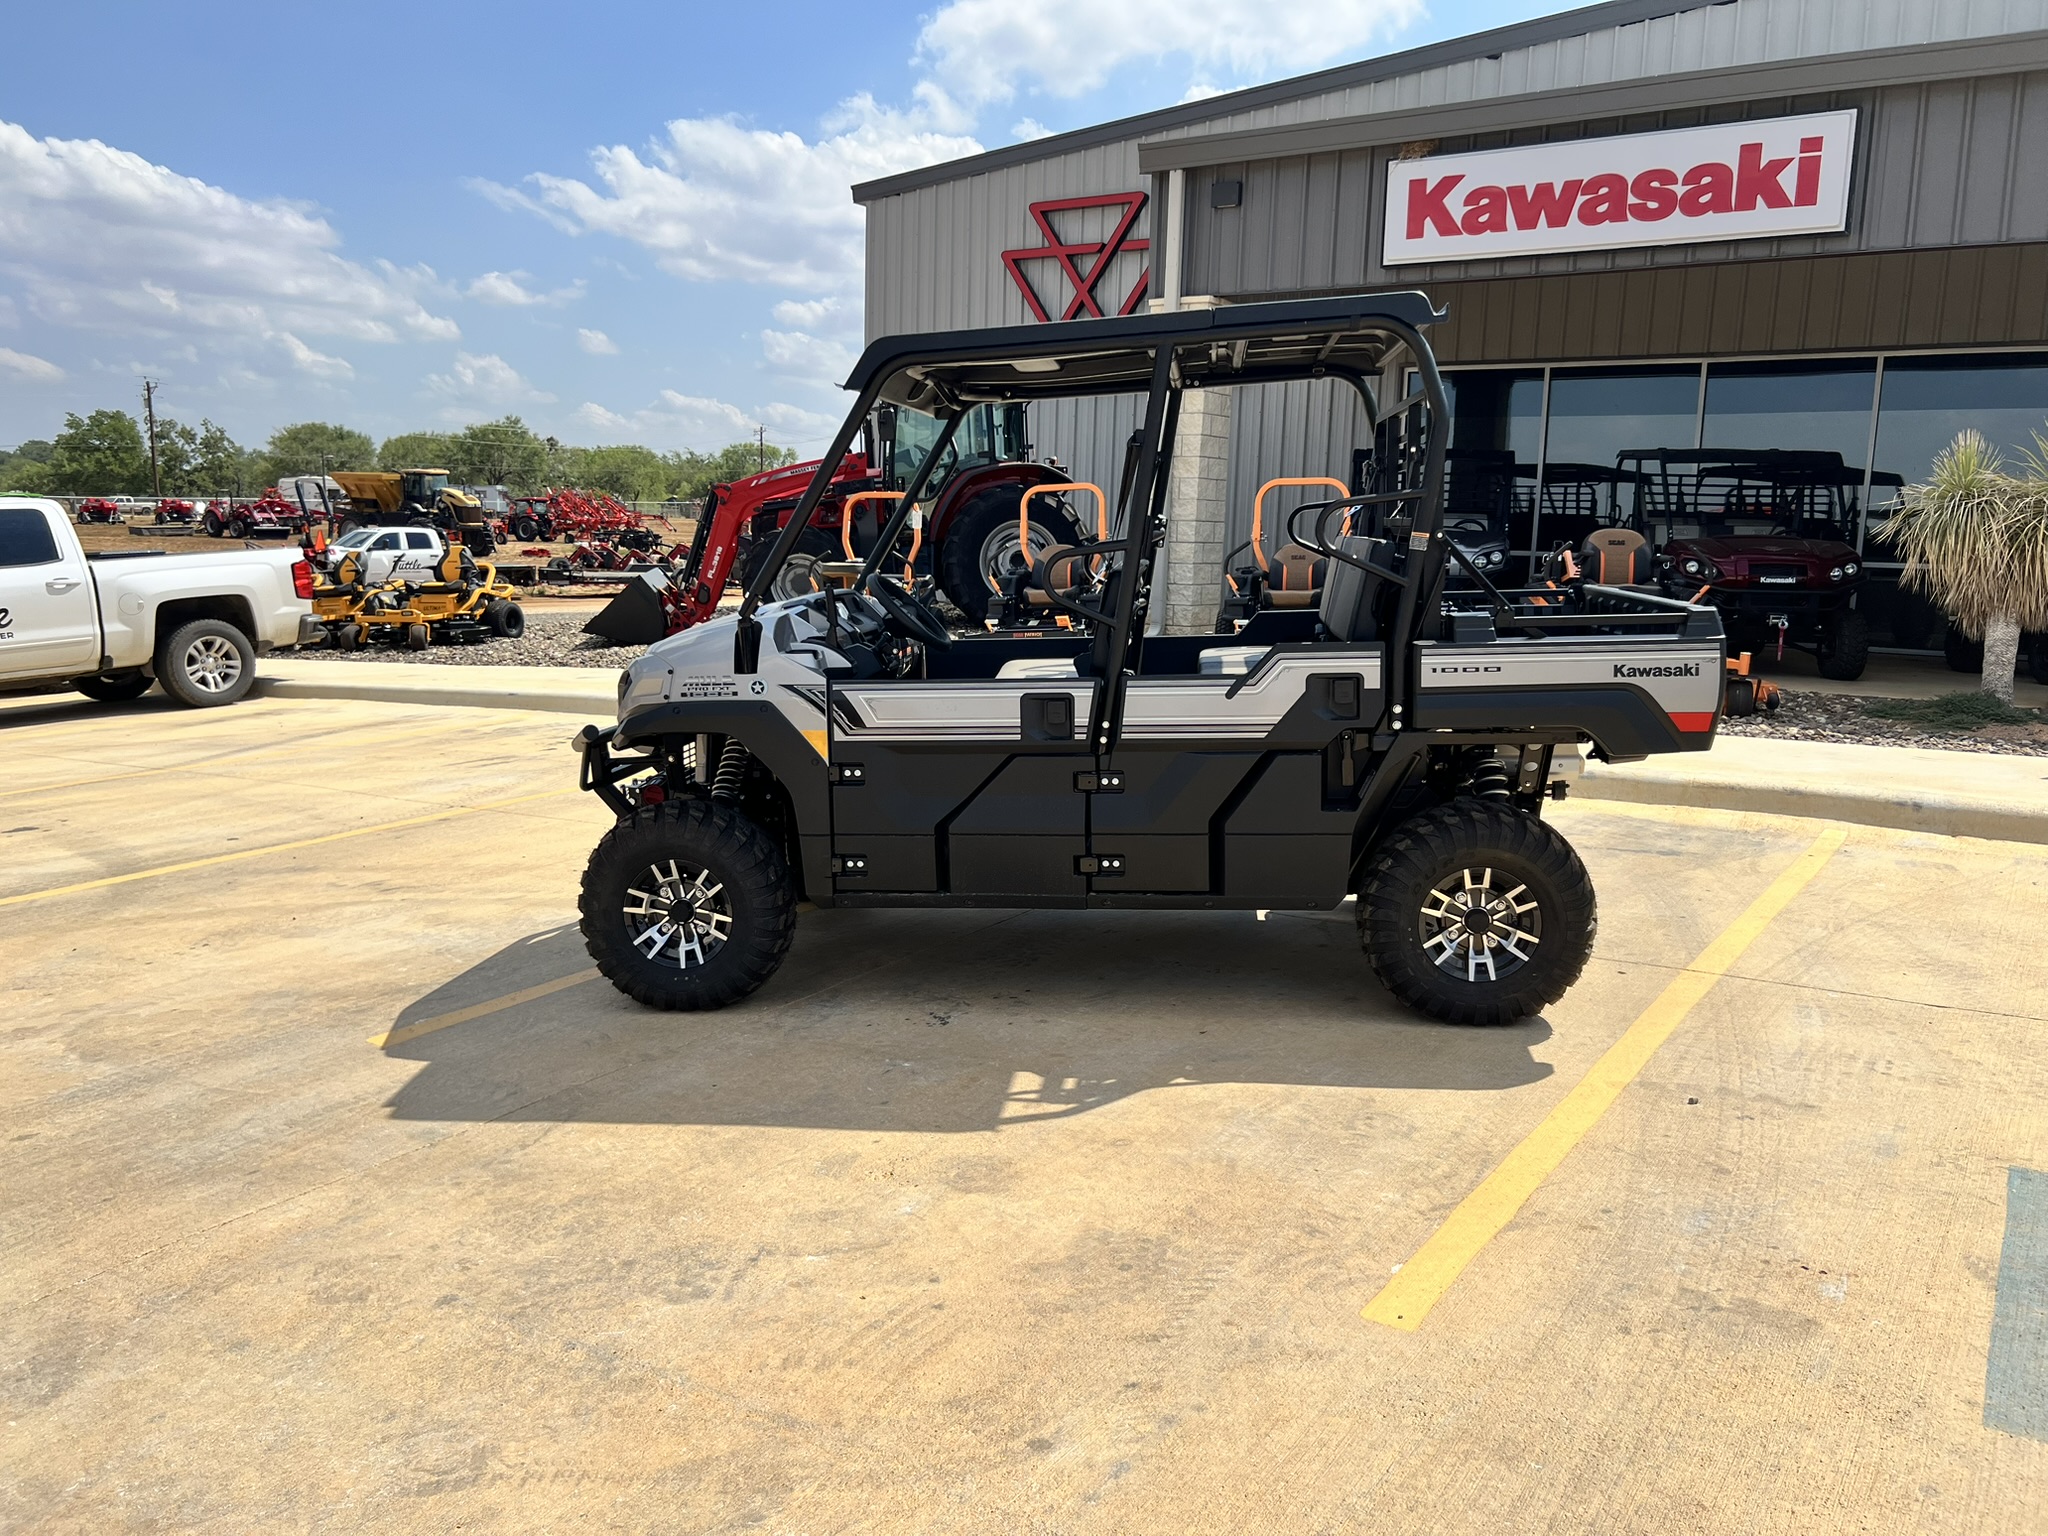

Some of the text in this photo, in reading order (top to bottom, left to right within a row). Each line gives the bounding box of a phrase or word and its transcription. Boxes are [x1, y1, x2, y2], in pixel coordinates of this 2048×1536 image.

[1405, 135, 1824, 240] Kawasaki
[790, 467, 810, 475] MASSEY
[1760, 576, 1796, 584] Kawasaki
[1431, 666, 1502, 674] 1000
[1613, 663, 1700, 678] Kawasaki
